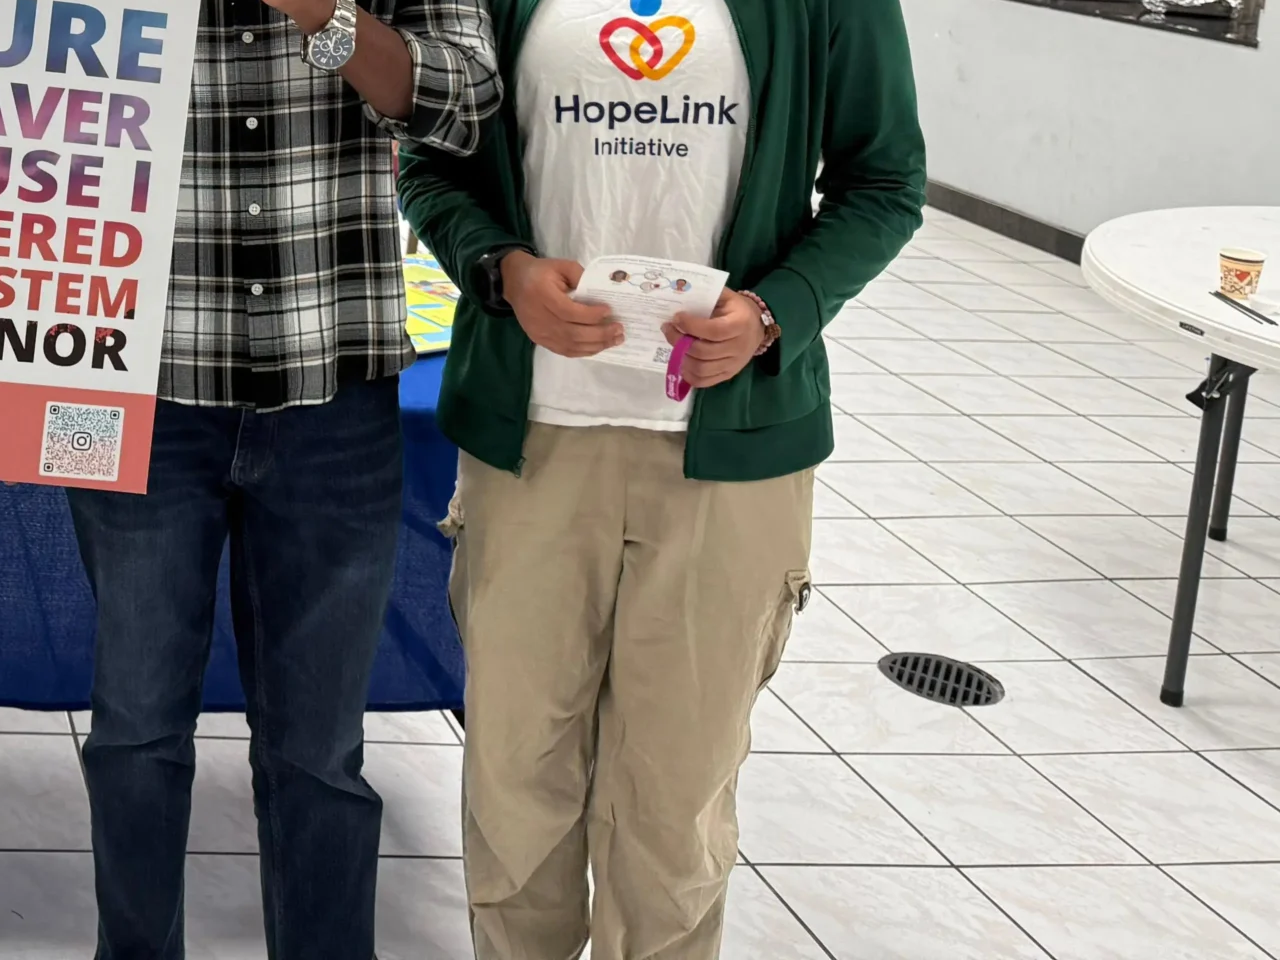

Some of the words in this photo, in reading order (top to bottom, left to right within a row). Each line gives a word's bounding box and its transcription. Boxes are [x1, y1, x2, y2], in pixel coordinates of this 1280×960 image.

[554, 94, 740, 129] HopeLink
[594, 138, 689, 158] Initiative
[131, 160, 151, 213] I
